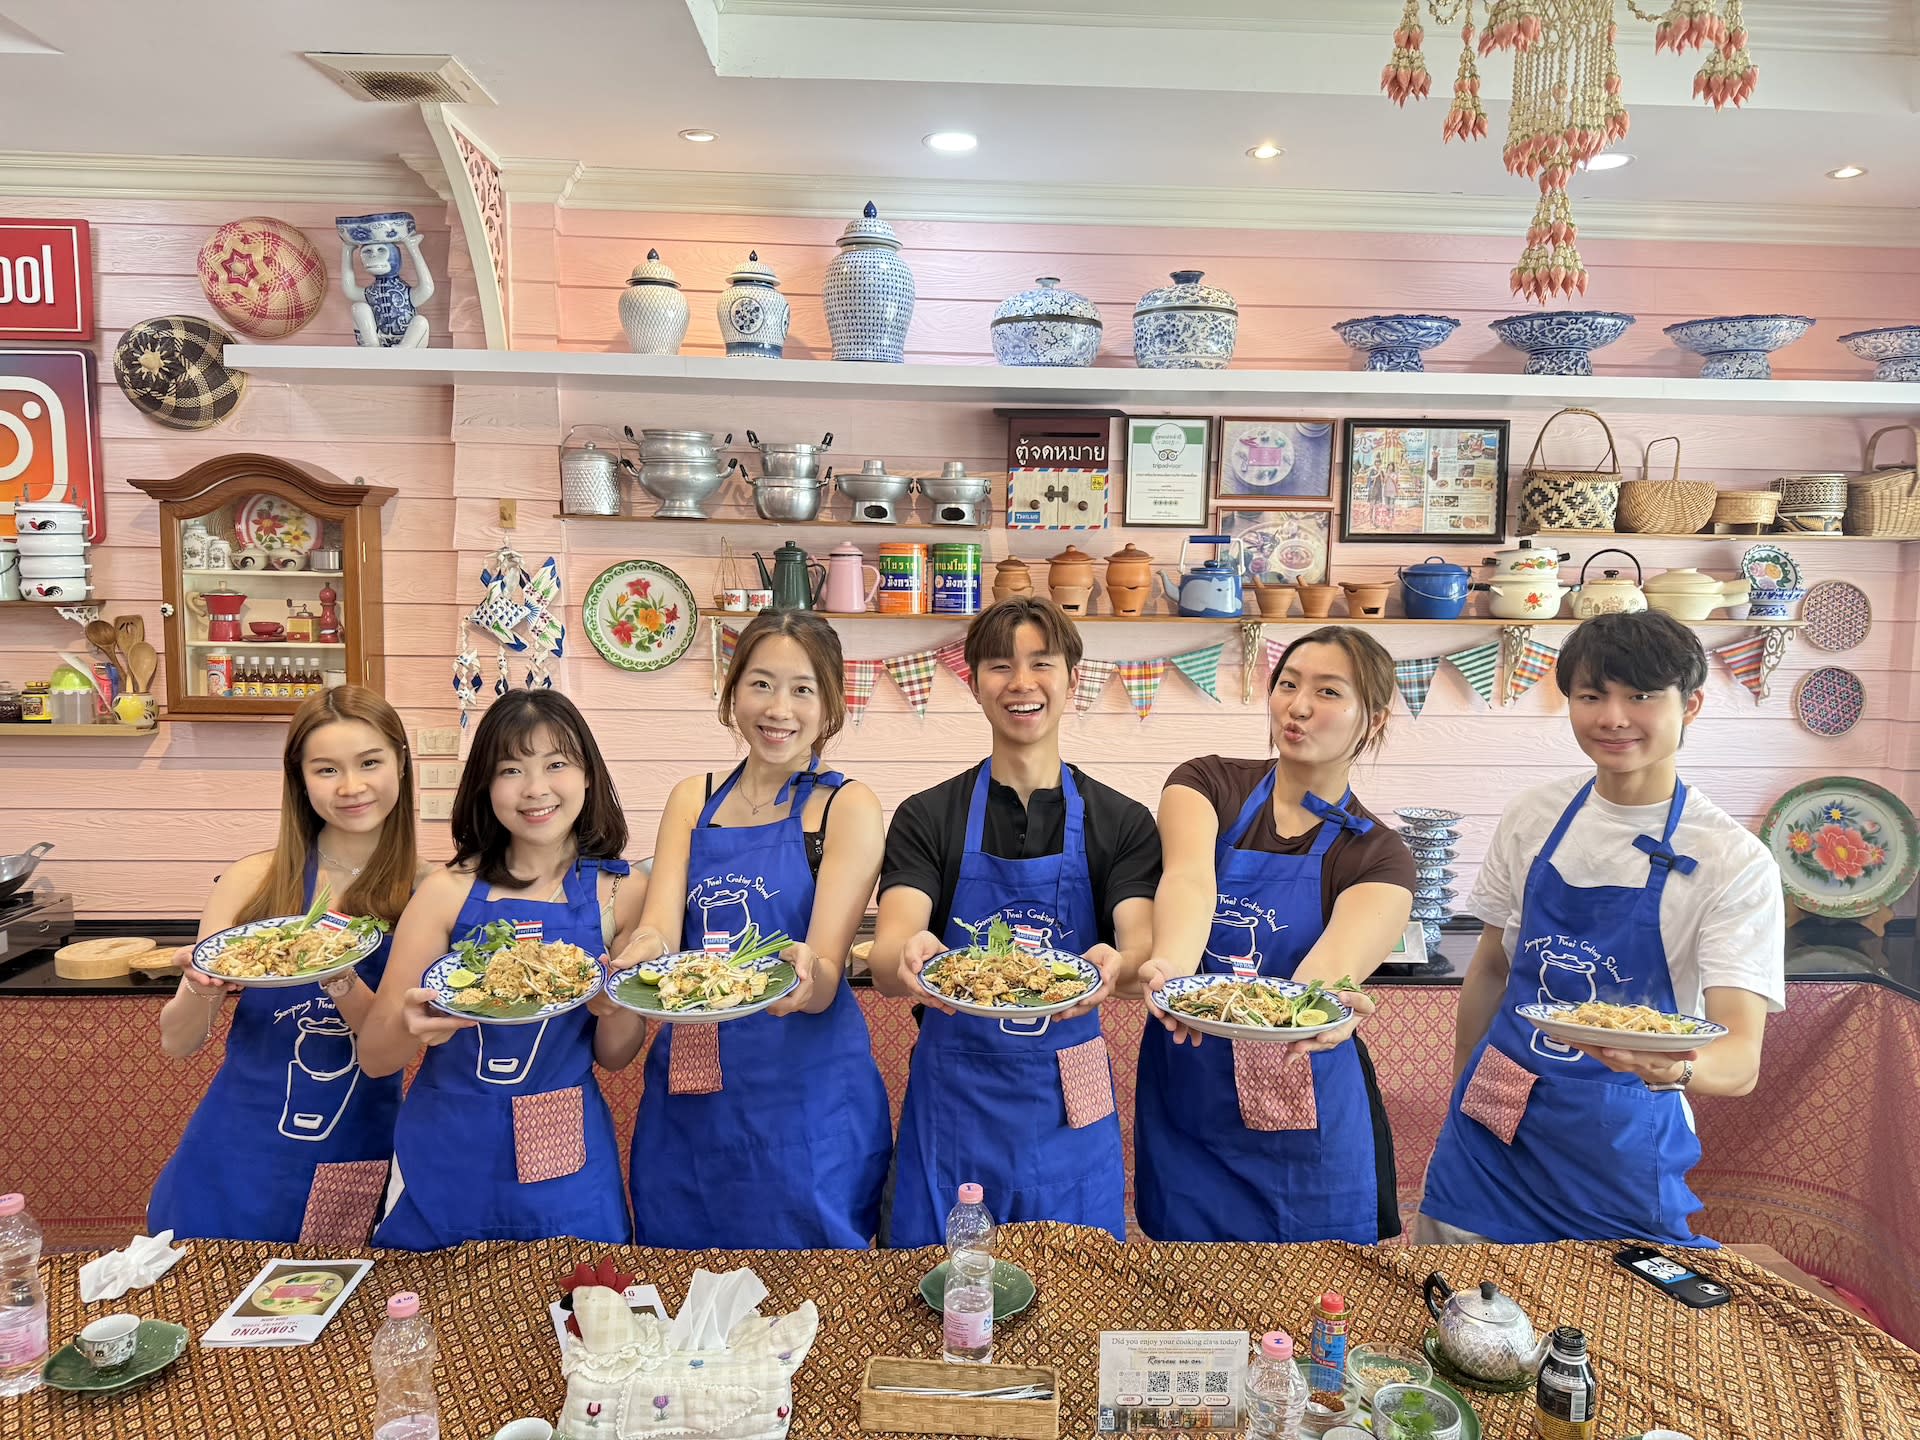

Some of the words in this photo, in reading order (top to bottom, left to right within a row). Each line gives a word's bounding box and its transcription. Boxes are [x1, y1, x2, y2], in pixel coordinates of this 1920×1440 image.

[1015, 438, 1105, 466] ตู้จดหมาย
[231, 1325, 297, 1336] SOMPONG
[1126, 1339, 1139, 1347] you
[1139, 1338, 1158, 1347] enjoy
[1159, 1339, 1175, 1347] your
[1175, 1338, 1202, 1347] cooking
[1219, 1338, 1242, 1347] today?
